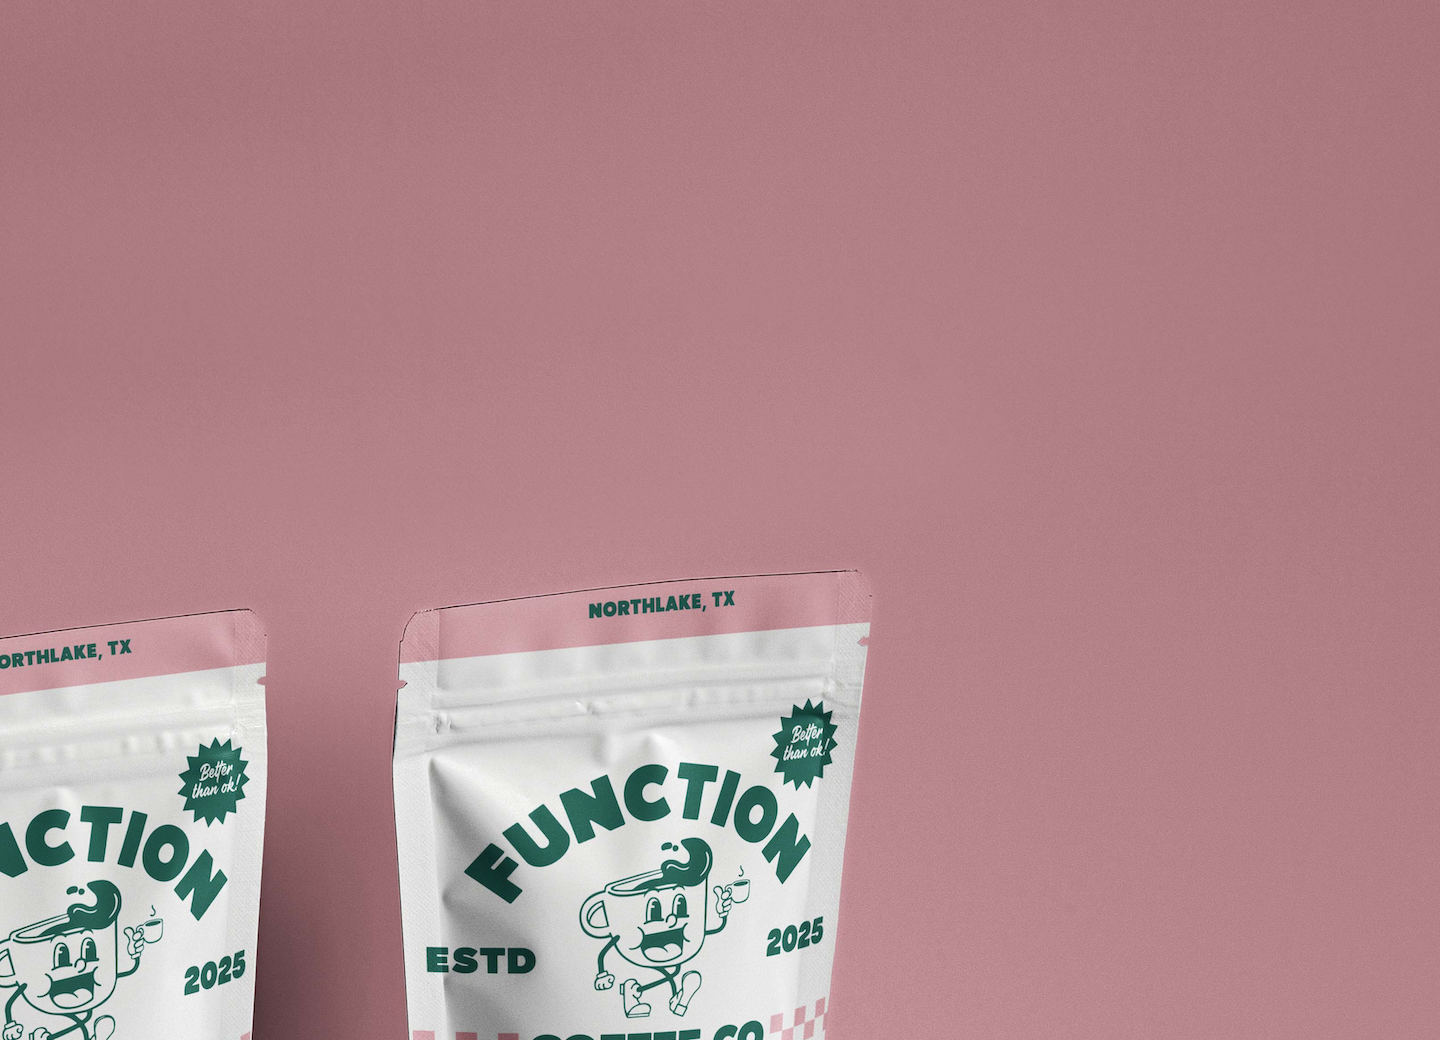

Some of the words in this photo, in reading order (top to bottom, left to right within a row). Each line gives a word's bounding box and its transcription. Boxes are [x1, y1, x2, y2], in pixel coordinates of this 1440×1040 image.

[589, 594, 707, 619] NORTHLAKE,
[712, 591, 735, 607] TX
[107, 639, 132, 655] TX
[791, 723, 823, 746] Better
[783, 744, 809, 761] than
[810, 738, 830, 757] ok!
[199, 760, 233, 783] Better
[192, 782, 219, 799] than
[221, 774, 240, 793] ok!
[464, 762, 812, 904] FUNCTION
[766, 916, 824, 957] 2025
[184, 950, 246, 995] 2025
[426, 946, 537, 975] ESTD
